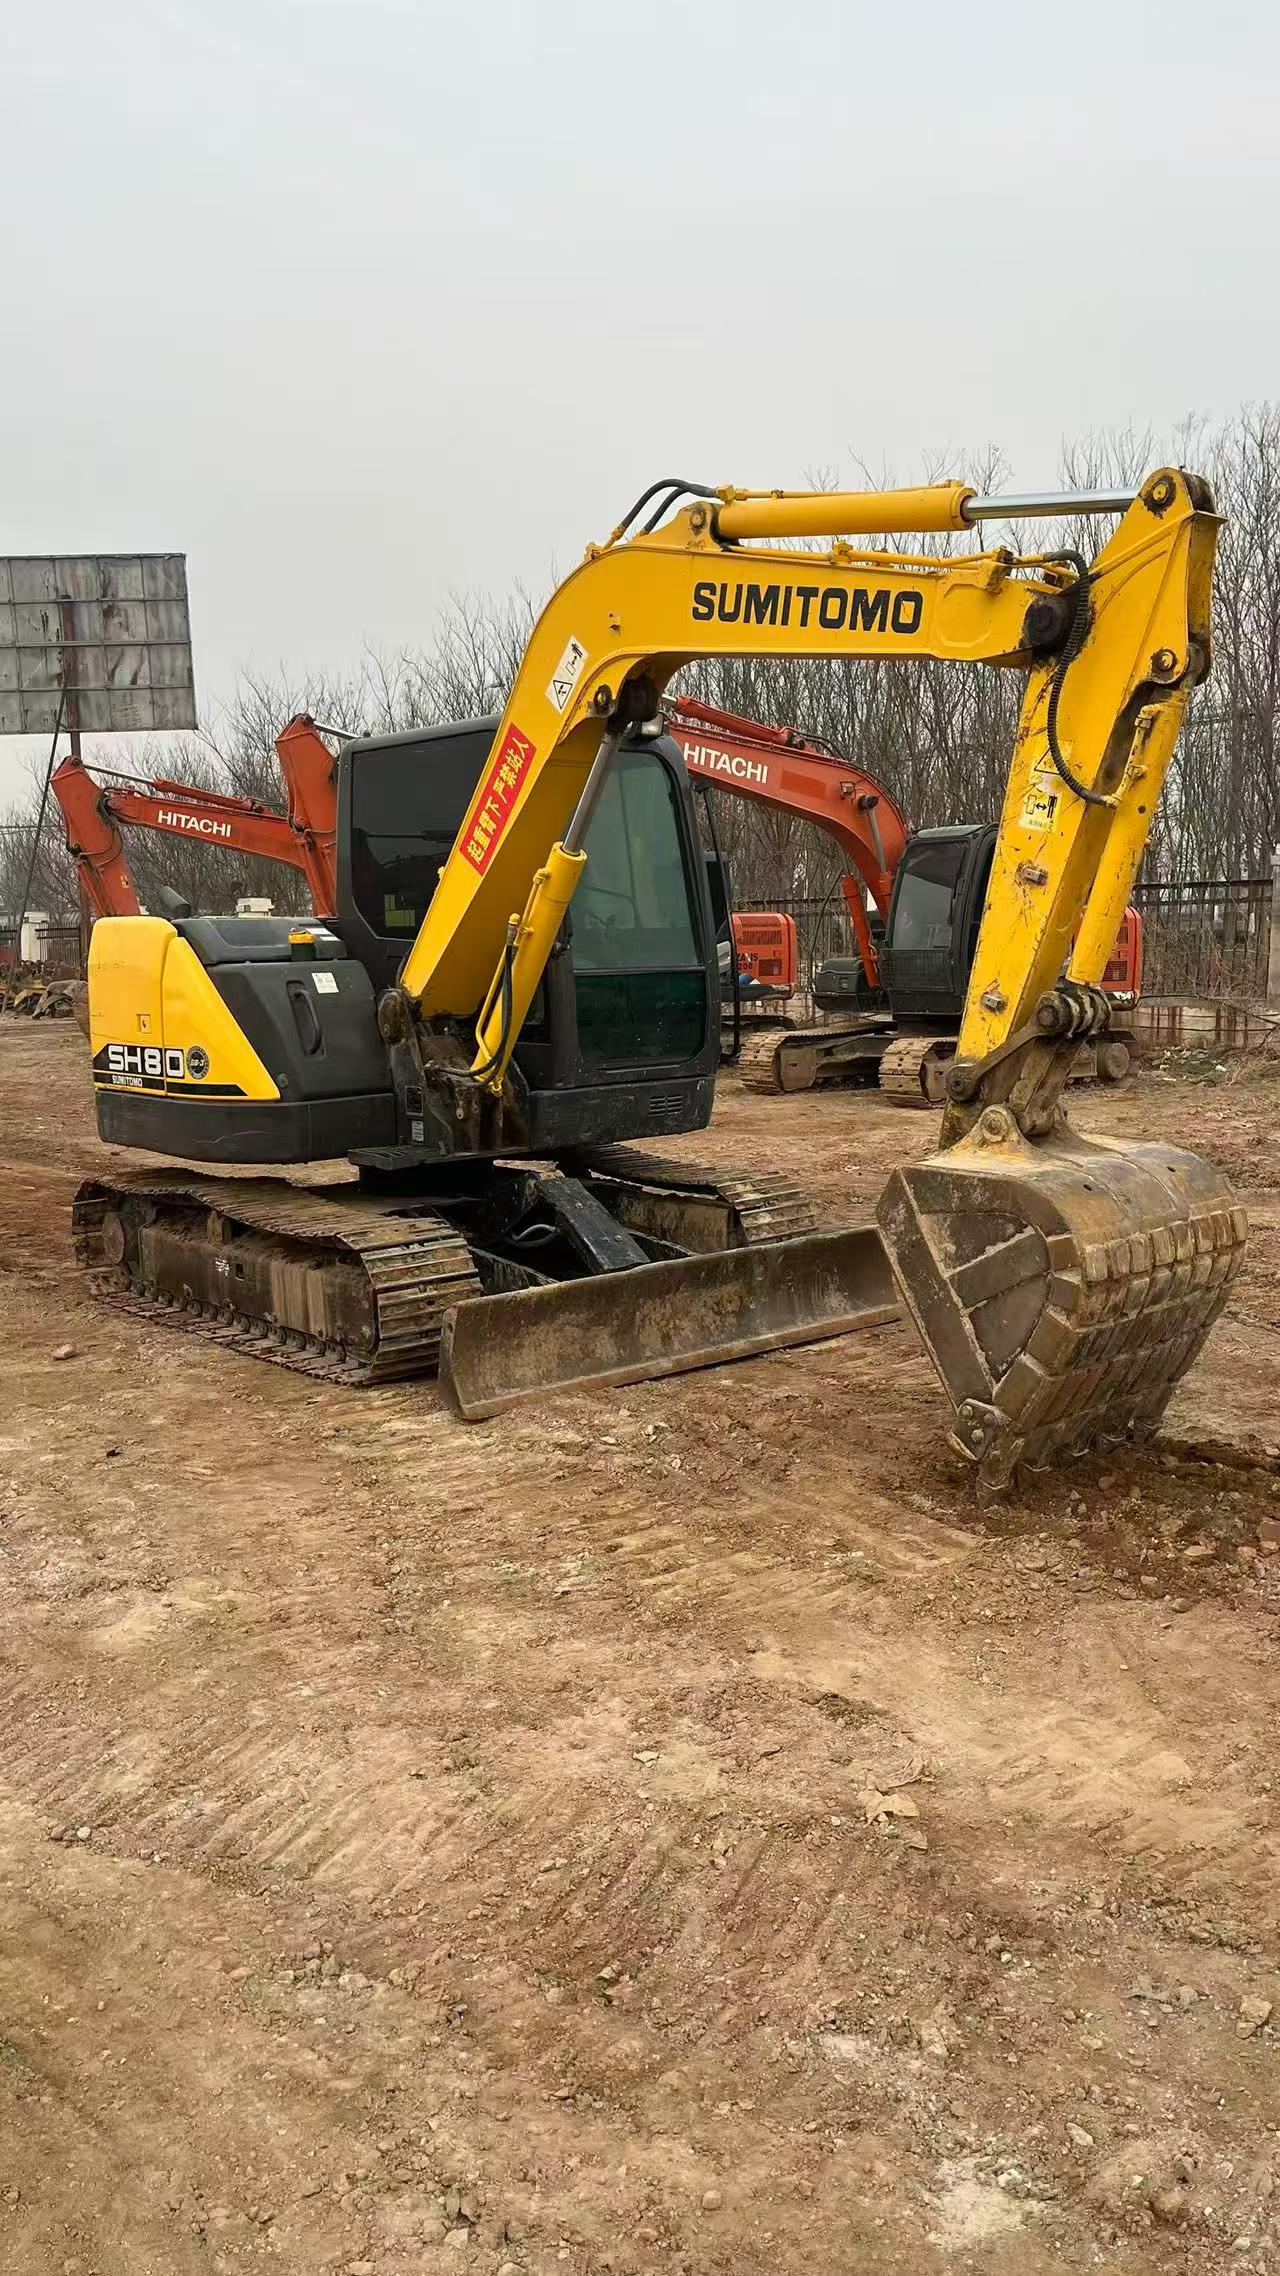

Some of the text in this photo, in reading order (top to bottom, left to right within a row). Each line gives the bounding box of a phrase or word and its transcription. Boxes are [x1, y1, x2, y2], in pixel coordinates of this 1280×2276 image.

[691, 581, 924, 635] SUMITOMO
[683, 742, 768, 784] HITACHI
[157, 810, 232, 838] HITACHI
[108, 1044, 185, 1077] SH80
[111, 1074, 143, 1087] SUMITOMO
